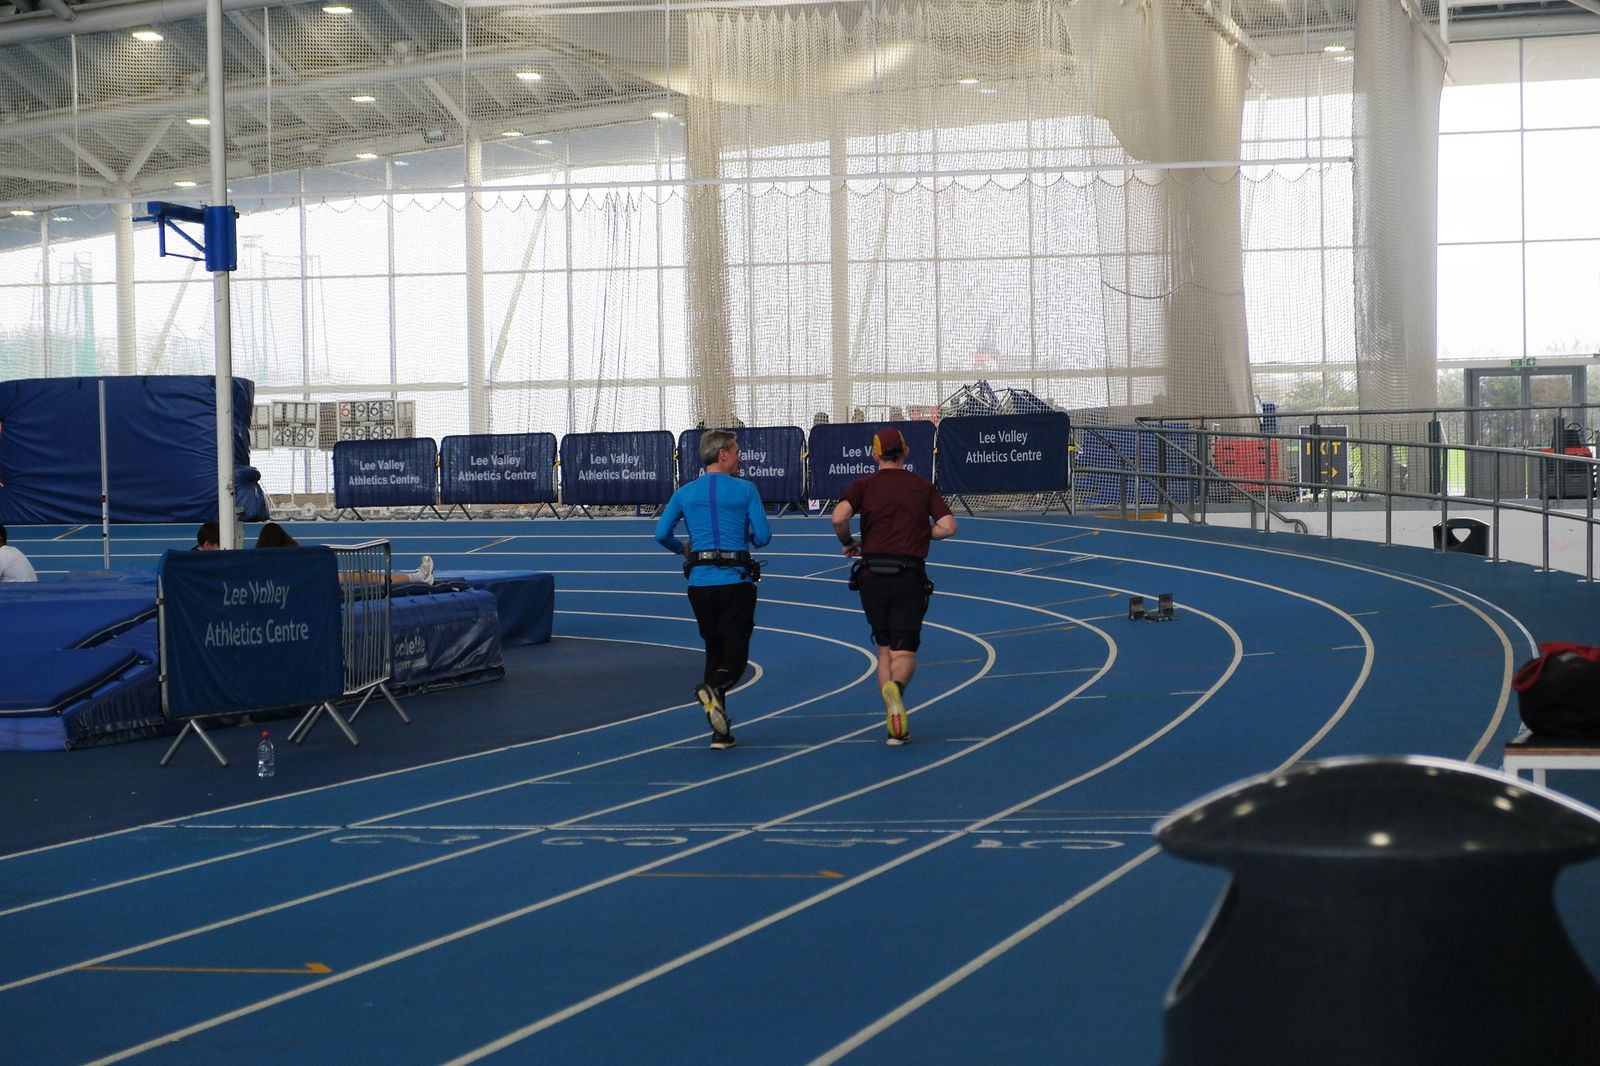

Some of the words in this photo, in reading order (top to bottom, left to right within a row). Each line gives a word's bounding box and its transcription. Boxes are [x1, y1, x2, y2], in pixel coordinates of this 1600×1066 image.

[979, 431, 996, 444] Lee
[998, 430, 1028, 446] Valley
[842, 446, 862, 458] Lee
[965, 450, 1008, 464] Athletics
[1010, 449, 1042, 462] Centre
[360, 460, 376, 470] Lee
[378, 460, 405, 472] Valley
[470, 455, 488, 466] Lee
[490, 454, 521, 467] Valley
[590, 453, 608, 465] Lee
[610, 453, 640, 467] Valley
[458, 470, 501, 481] Athletics
[504, 469, 537, 480] Centre
[578, 469, 620, 481] Athletics
[621, 469, 656, 480] Centre
[748, 465, 785, 477] Centre
[828, 462, 875, 475] Athletics
[349, 475, 388, 486] Athletics
[390, 474, 420, 485] Centre
[223, 582, 248, 606] Lee
[249, 579, 290, 610] Valley
[205, 619, 262, 647] Athletics
[265, 618, 309, 644] Centre
